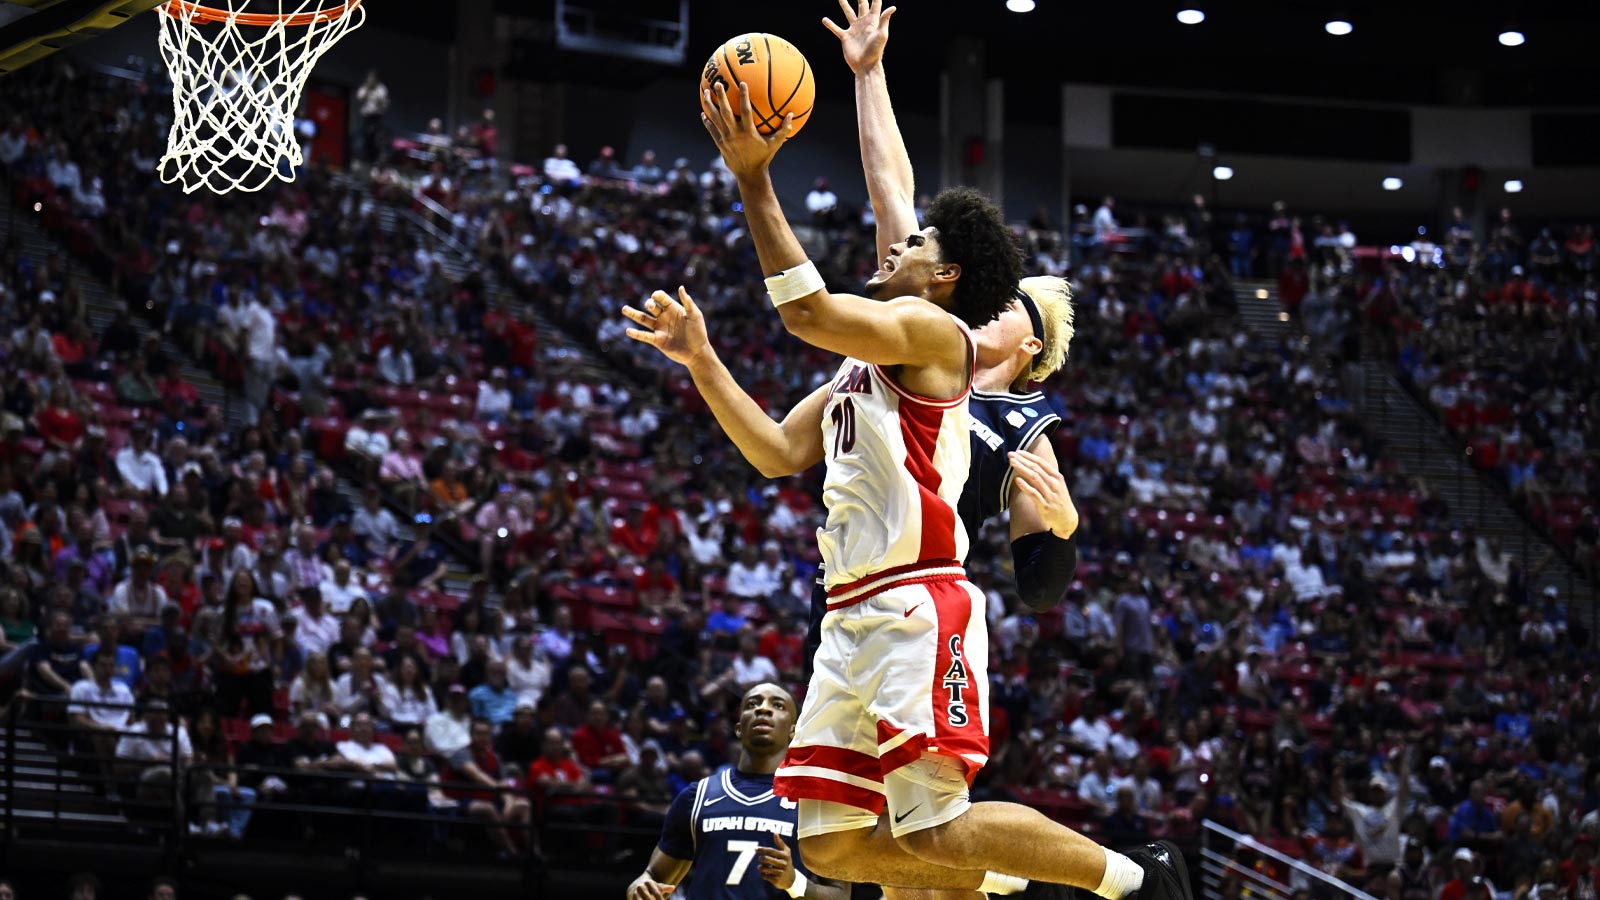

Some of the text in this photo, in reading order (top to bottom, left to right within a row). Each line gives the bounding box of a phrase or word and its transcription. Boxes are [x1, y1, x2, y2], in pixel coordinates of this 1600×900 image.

[831, 396, 857, 461] 10
[943, 634, 969, 727] CATS
[702, 816, 795, 837] UTAH STATE
[725, 839, 759, 885] 7
